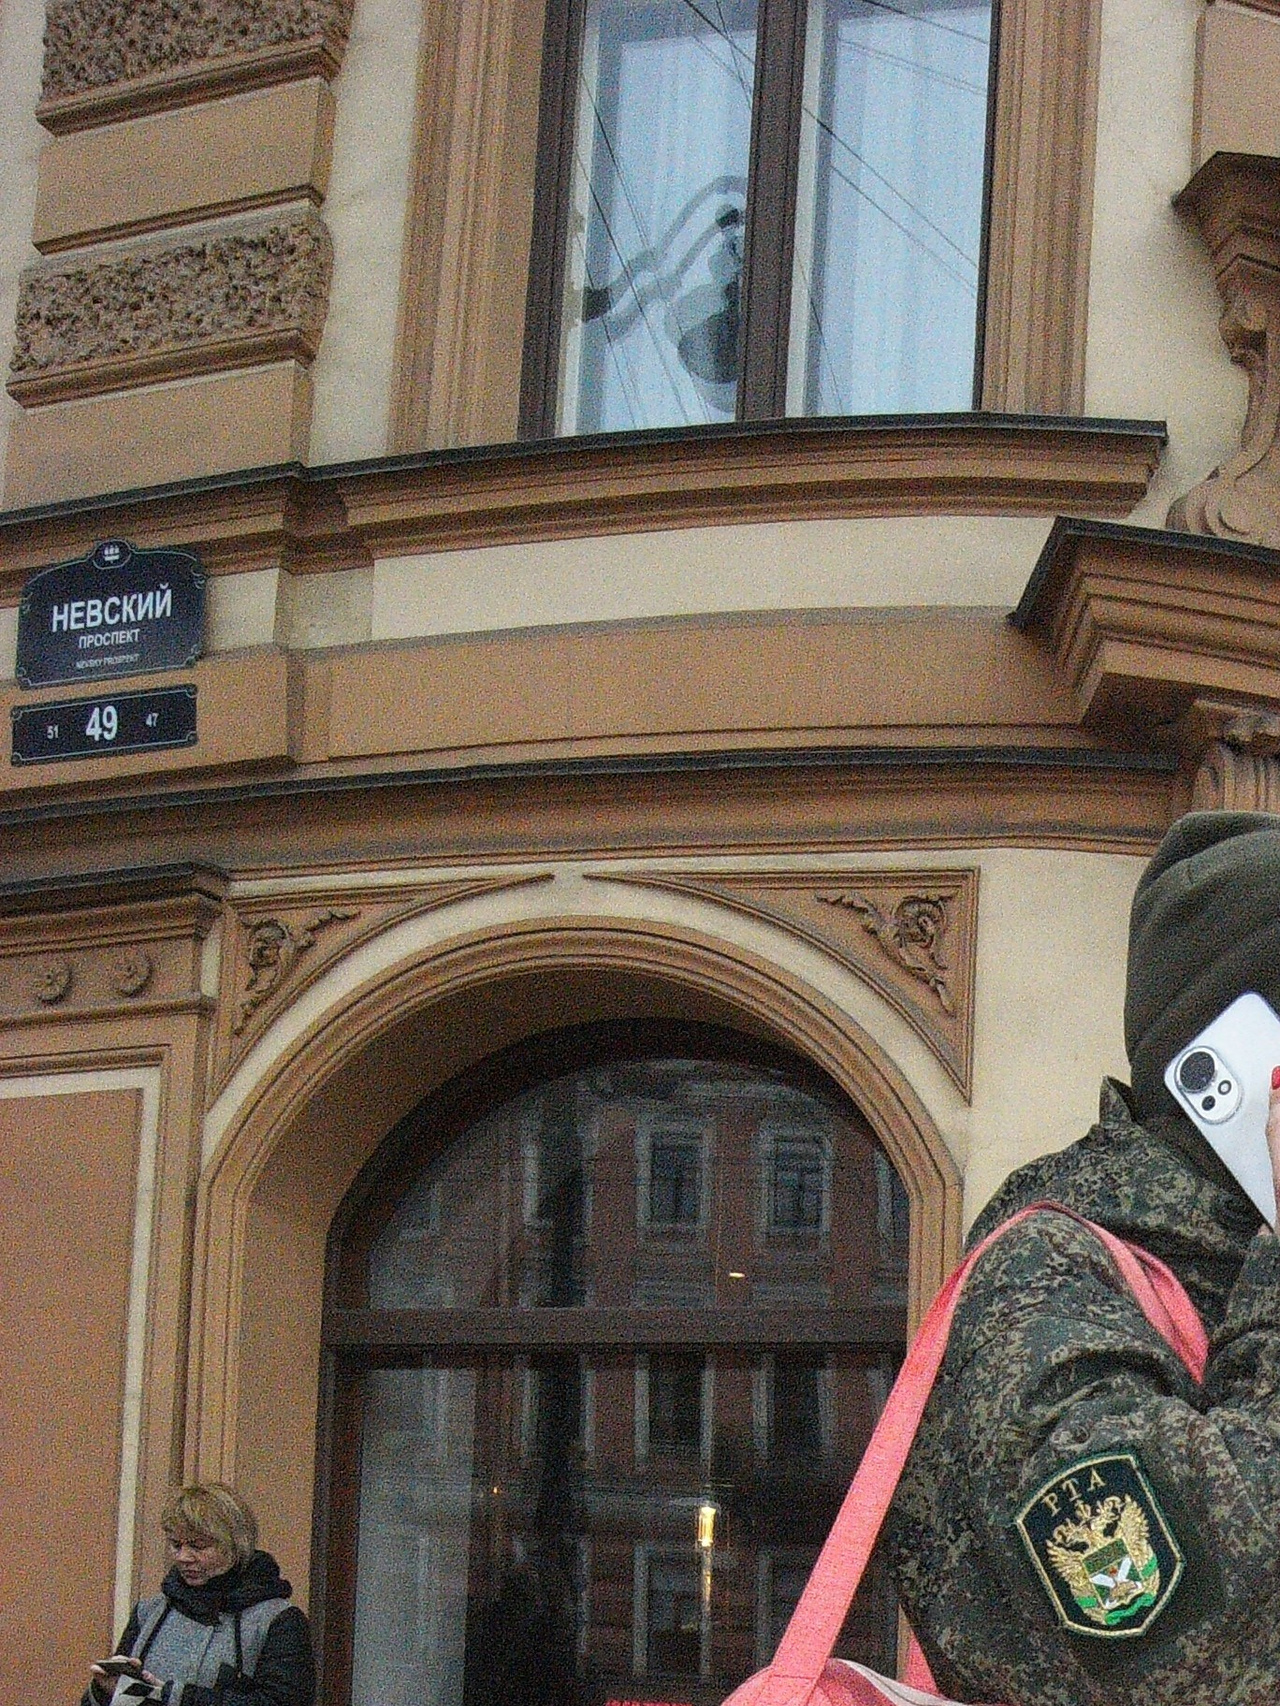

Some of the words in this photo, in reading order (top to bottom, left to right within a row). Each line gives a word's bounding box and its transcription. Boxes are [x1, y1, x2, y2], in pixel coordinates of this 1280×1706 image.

[52, 583, 172, 632] НЕВСКИЙ
[79, 629, 140, 649] ПРОСПЕКТ
[47, 725, 59, 739] 51
[86, 705, 118, 741] 49
[146, 713, 159, 727] 47
